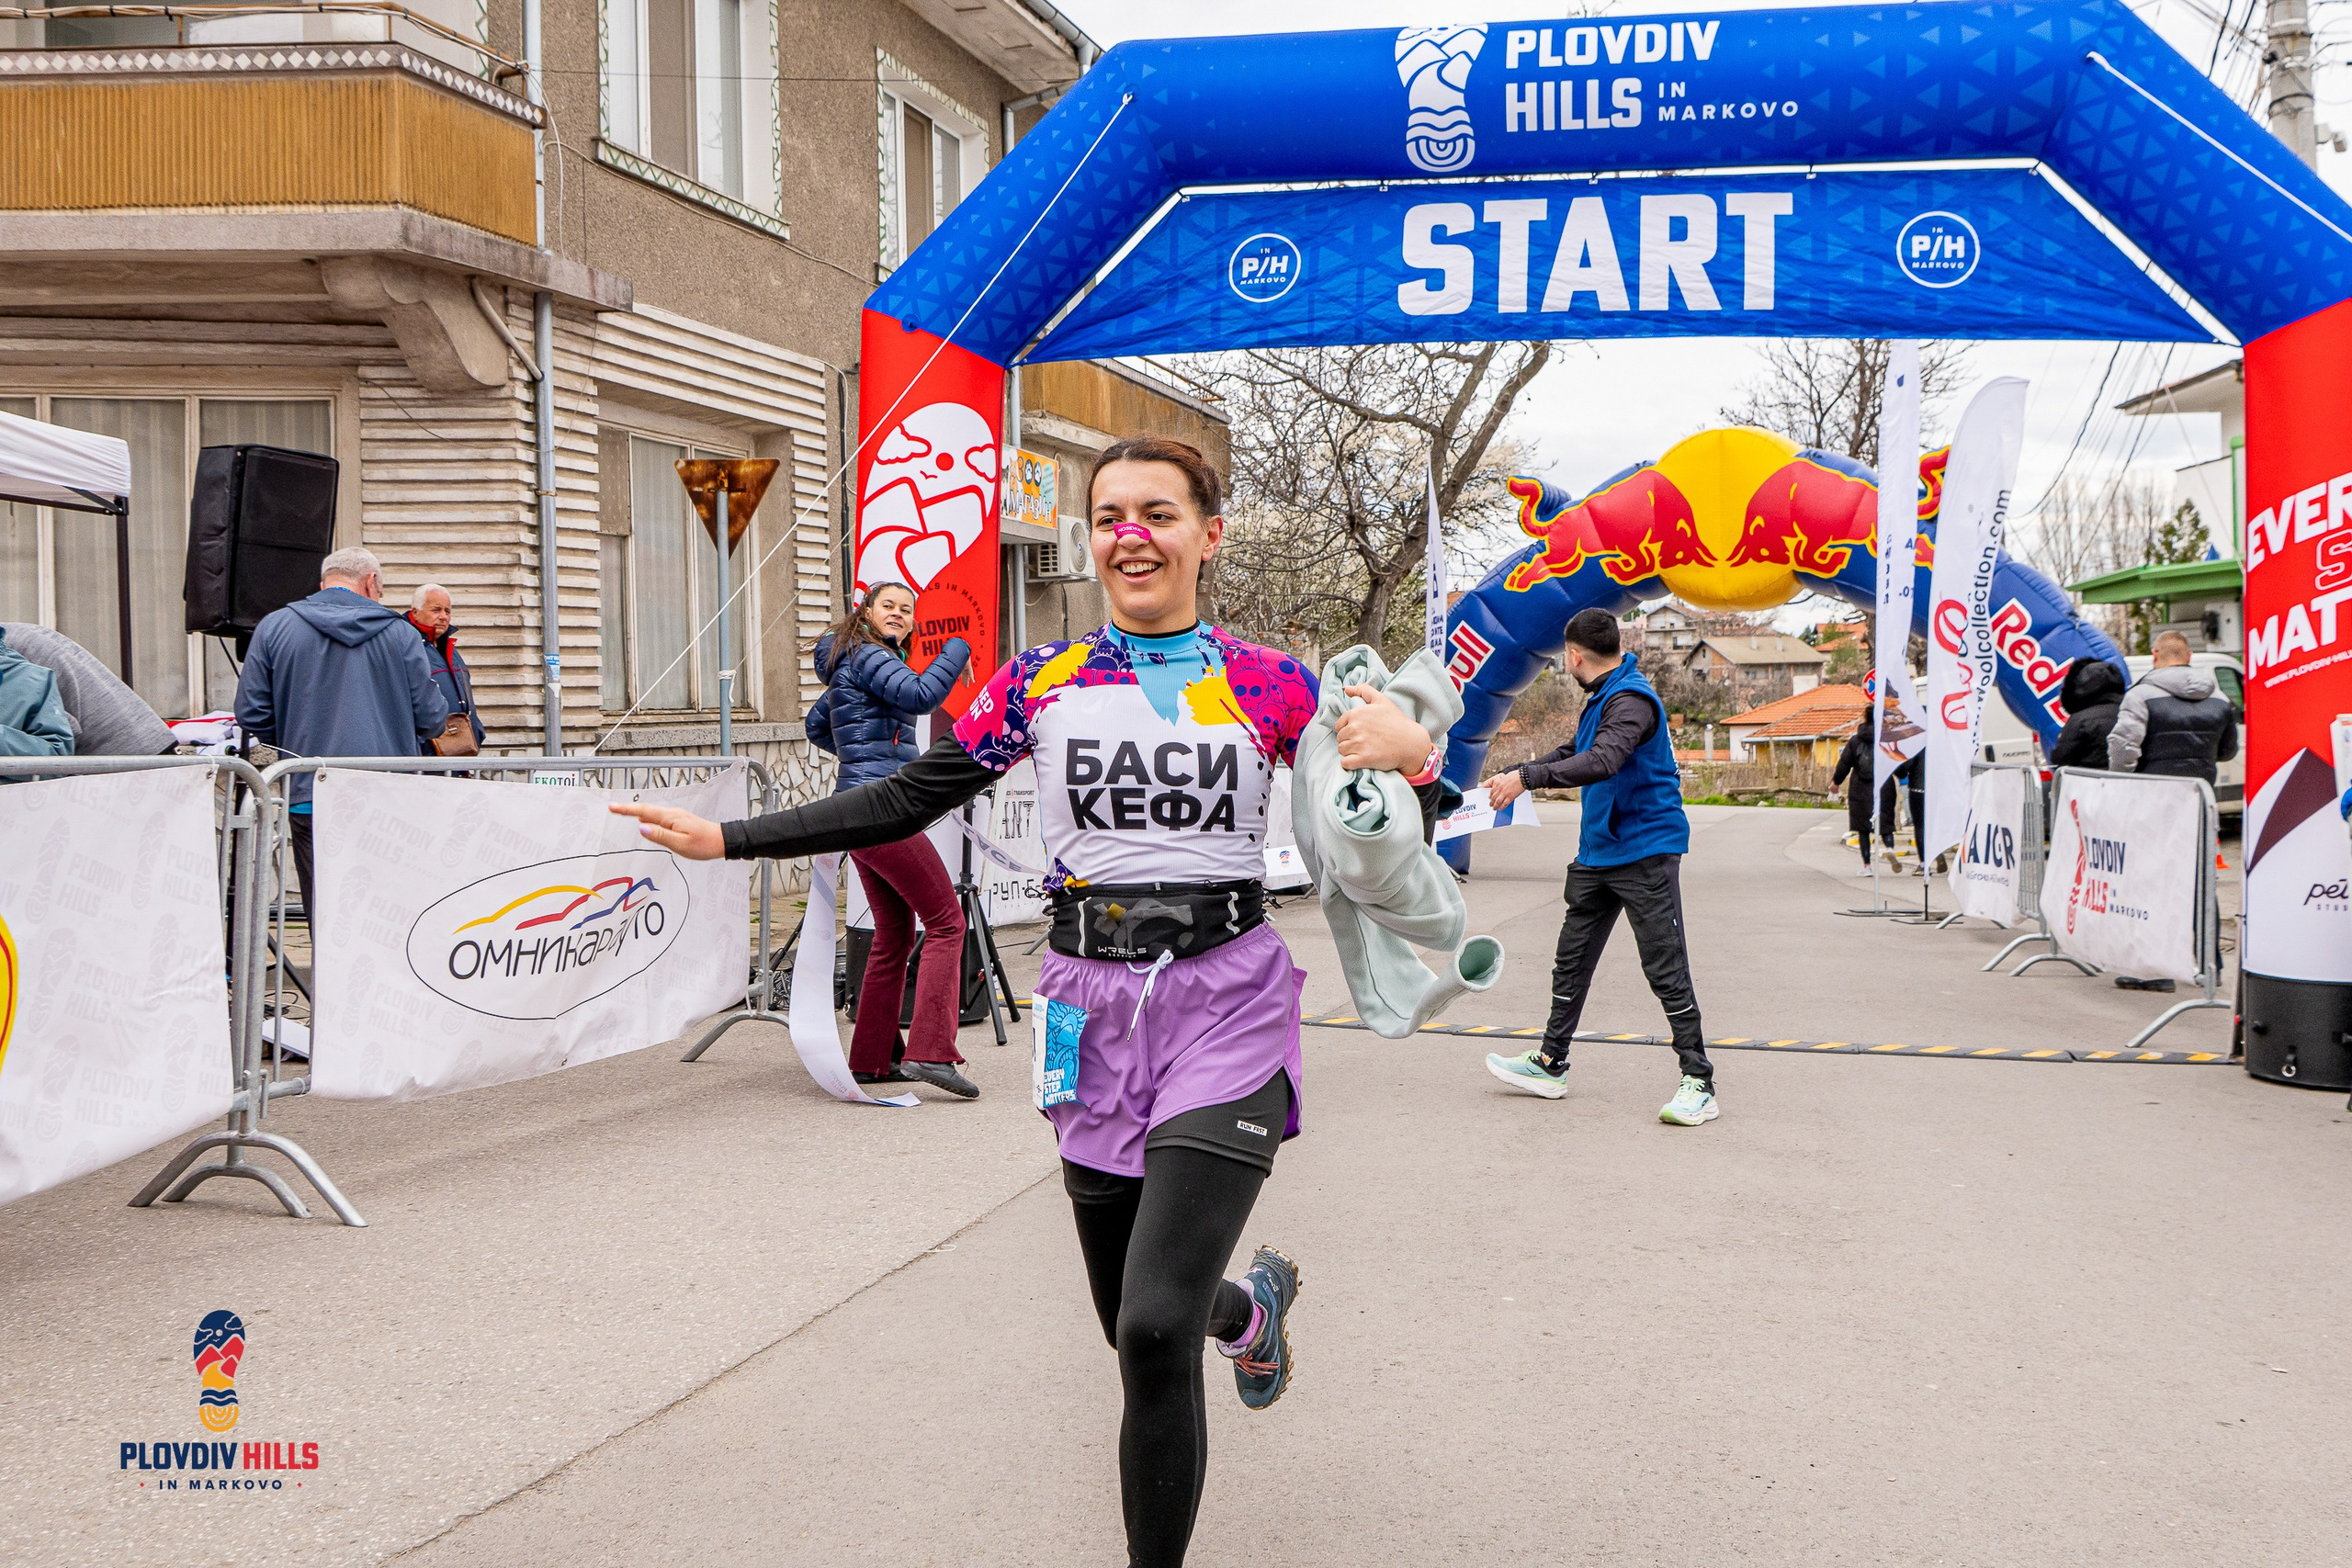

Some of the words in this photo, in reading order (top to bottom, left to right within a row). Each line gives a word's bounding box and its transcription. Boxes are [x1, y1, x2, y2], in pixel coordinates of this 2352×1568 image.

[1506, 20, 1720, 69] PLOVDIV
[1506, 77, 1642, 132] HILLS
[1658, 82, 1686, 99] IN
[1658, 101, 1798, 122] MARKOVO
[1397, 192, 1793, 316] START
[1239, 276, 1286, 286] MARKOVO
[918, 615, 970, 637] LOVDIV
[1067, 739, 1238, 792] БАСИ
[1068, 787, 1237, 832] КЕФА
